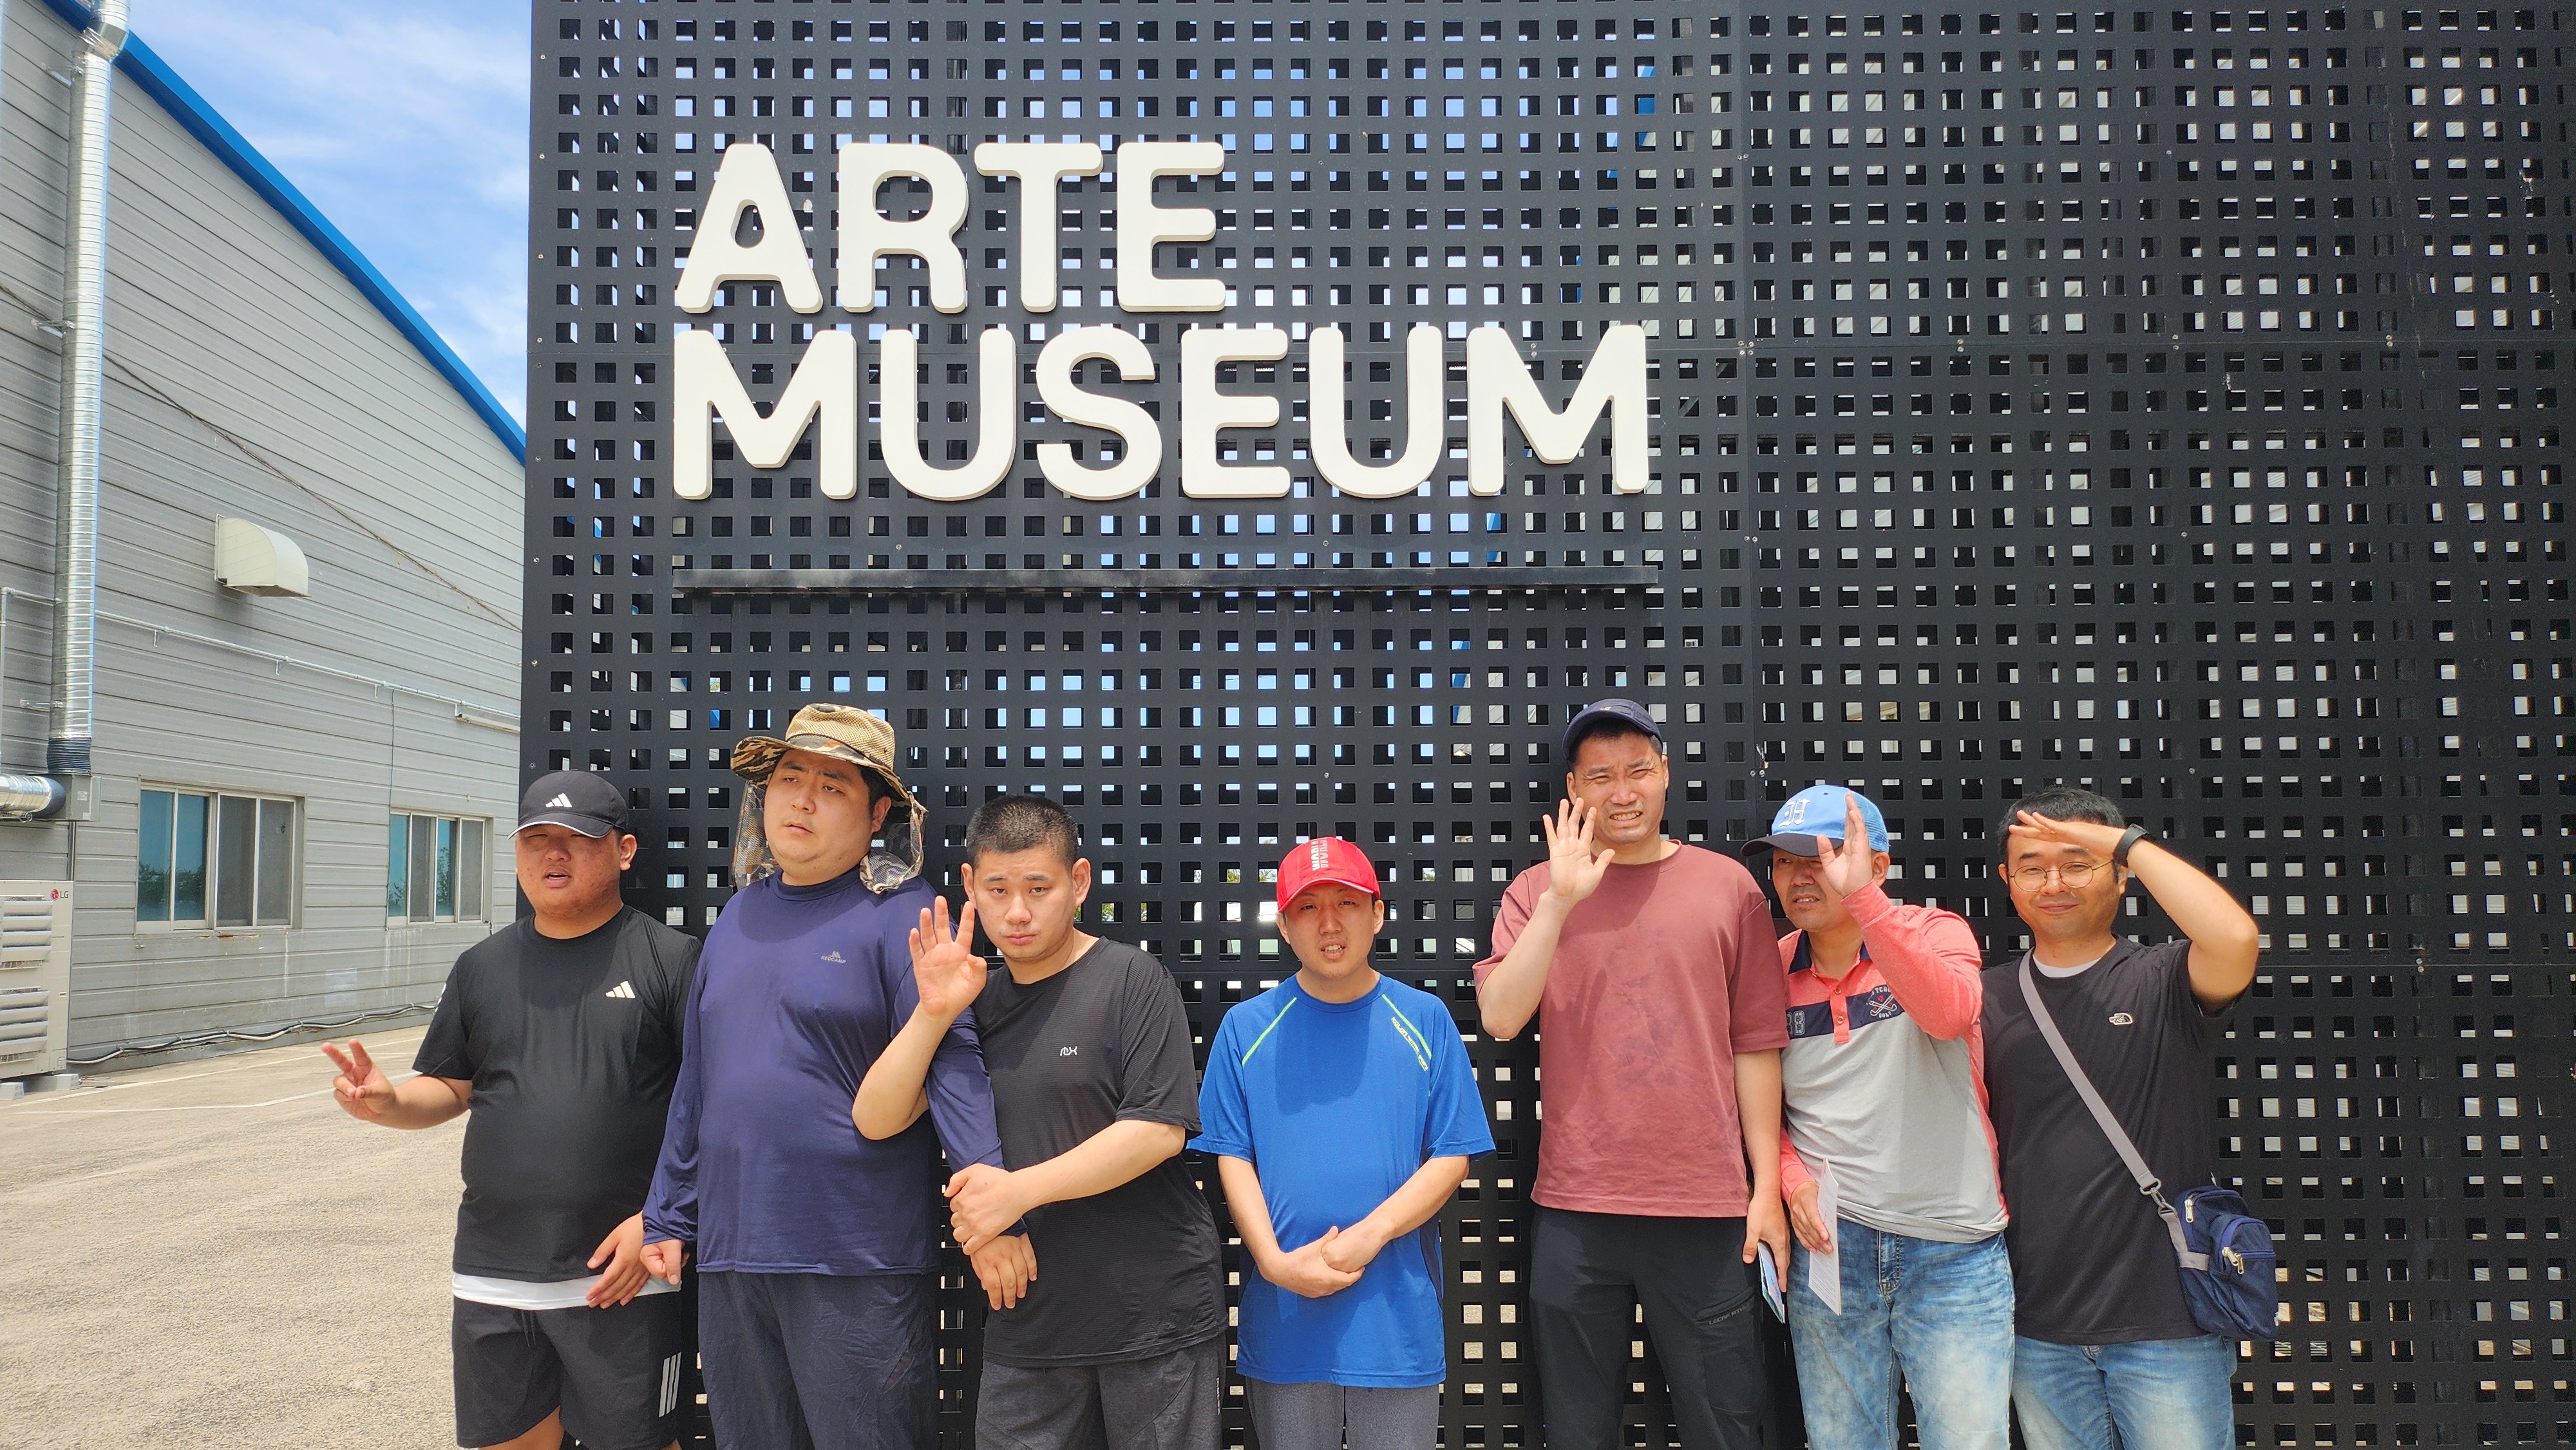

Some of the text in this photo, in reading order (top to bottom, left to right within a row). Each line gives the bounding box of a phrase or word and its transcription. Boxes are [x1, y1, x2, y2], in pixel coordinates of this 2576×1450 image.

[674, 142, 1227, 314] ARTE
[672, 324, 1650, 501] MUSEUM
[60, 890, 69, 899] LG
